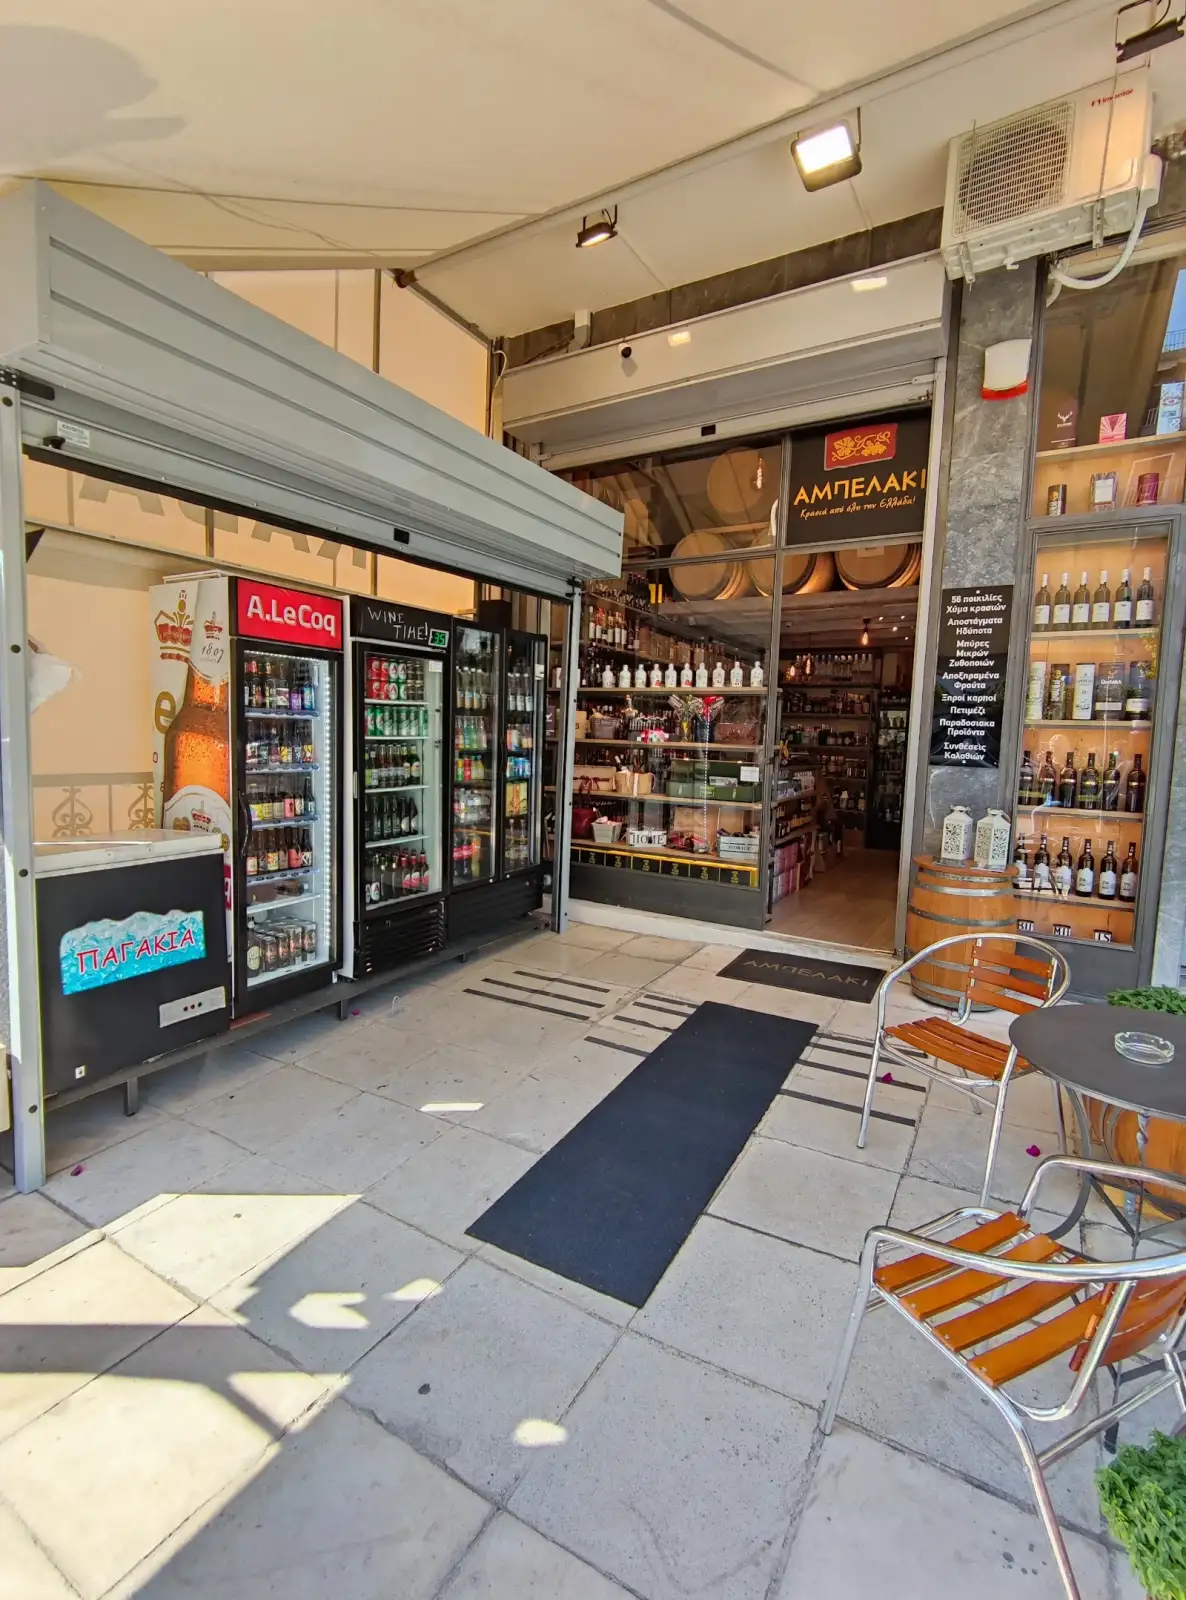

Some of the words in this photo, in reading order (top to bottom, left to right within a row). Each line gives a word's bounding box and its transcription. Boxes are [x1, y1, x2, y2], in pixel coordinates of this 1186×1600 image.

[793, 468, 927, 506] ΑΜΠΕΛΑΚΙ
[829, 504, 845, 516] από
[879, 495, 916, 509] Ελλάδα!
[963, 593, 1003, 603] ποικιλίες
[946, 605, 968, 614] Χύμα
[969, 602, 1007, 614] κρασιών
[367, 606, 405, 625] WINE
[947, 616, 1003, 626] Αποστάγματα
[393, 622, 429, 641] TIME!
[956, 627, 993, 635] Ηδύποτα
[956, 640, 990, 648] Μπύρες
[956, 649, 989, 658] Μικρών
[949, 659, 995, 667] Ζυθοποιών
[942, 671, 1000, 681] Αποξηραμένα
[954, 681, 986, 690] Φρούτα
[941, 693, 966, 703] Ξηροί
[967, 693, 997, 703] καρποί
[950, 706, 986, 715] Πετιμέζι
[947, 728, 986, 737] Προϊόντα
[943, 742, 987, 752] Συνθέσεις
[944, 752, 985, 760] Καλαθιών
[77, 929, 195, 974] ΠΑΓΑΚΙΑ
[743, 959, 869, 987] ΑΜΠΕΛΑΚΙ
